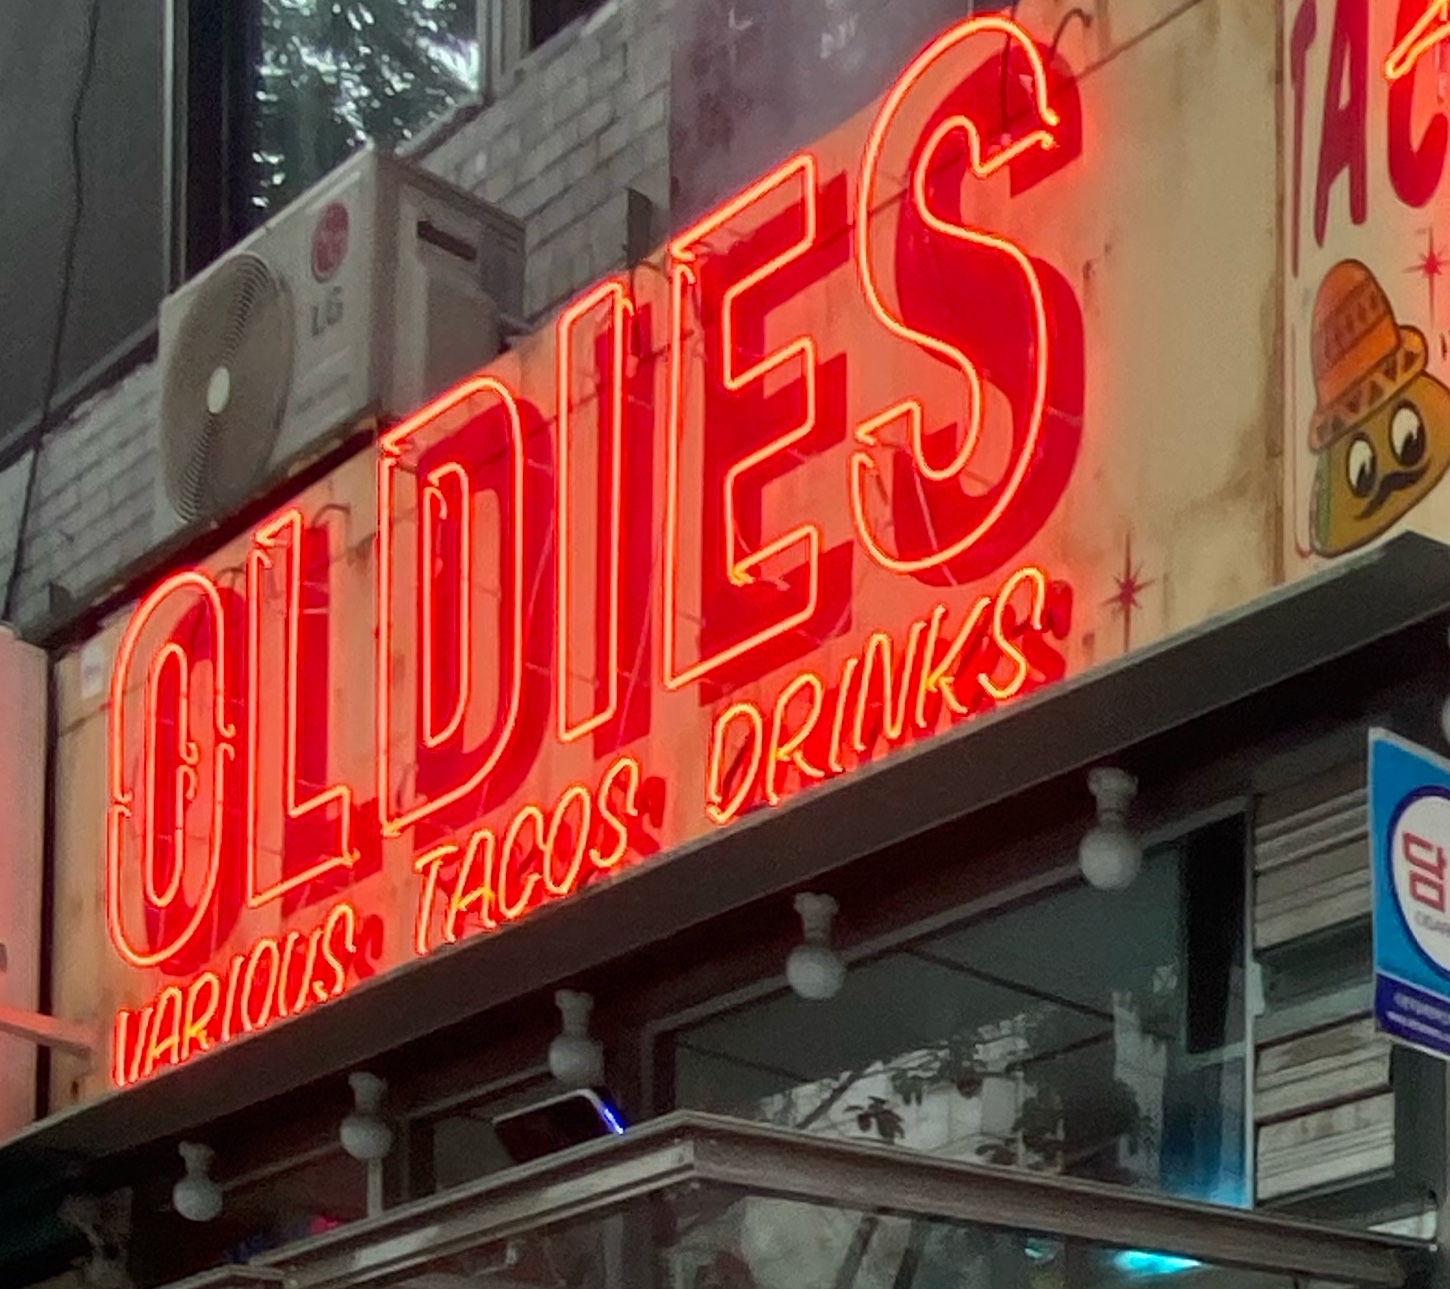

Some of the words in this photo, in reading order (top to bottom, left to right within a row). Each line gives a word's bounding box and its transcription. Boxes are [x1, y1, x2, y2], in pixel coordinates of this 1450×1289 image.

[108, 14, 1082, 967] OLDIES
[112, 902, 364, 1086] VARIOUS
[414, 757, 644, 956] TACOS
[704, 565, 1048, 826] DRINKS
